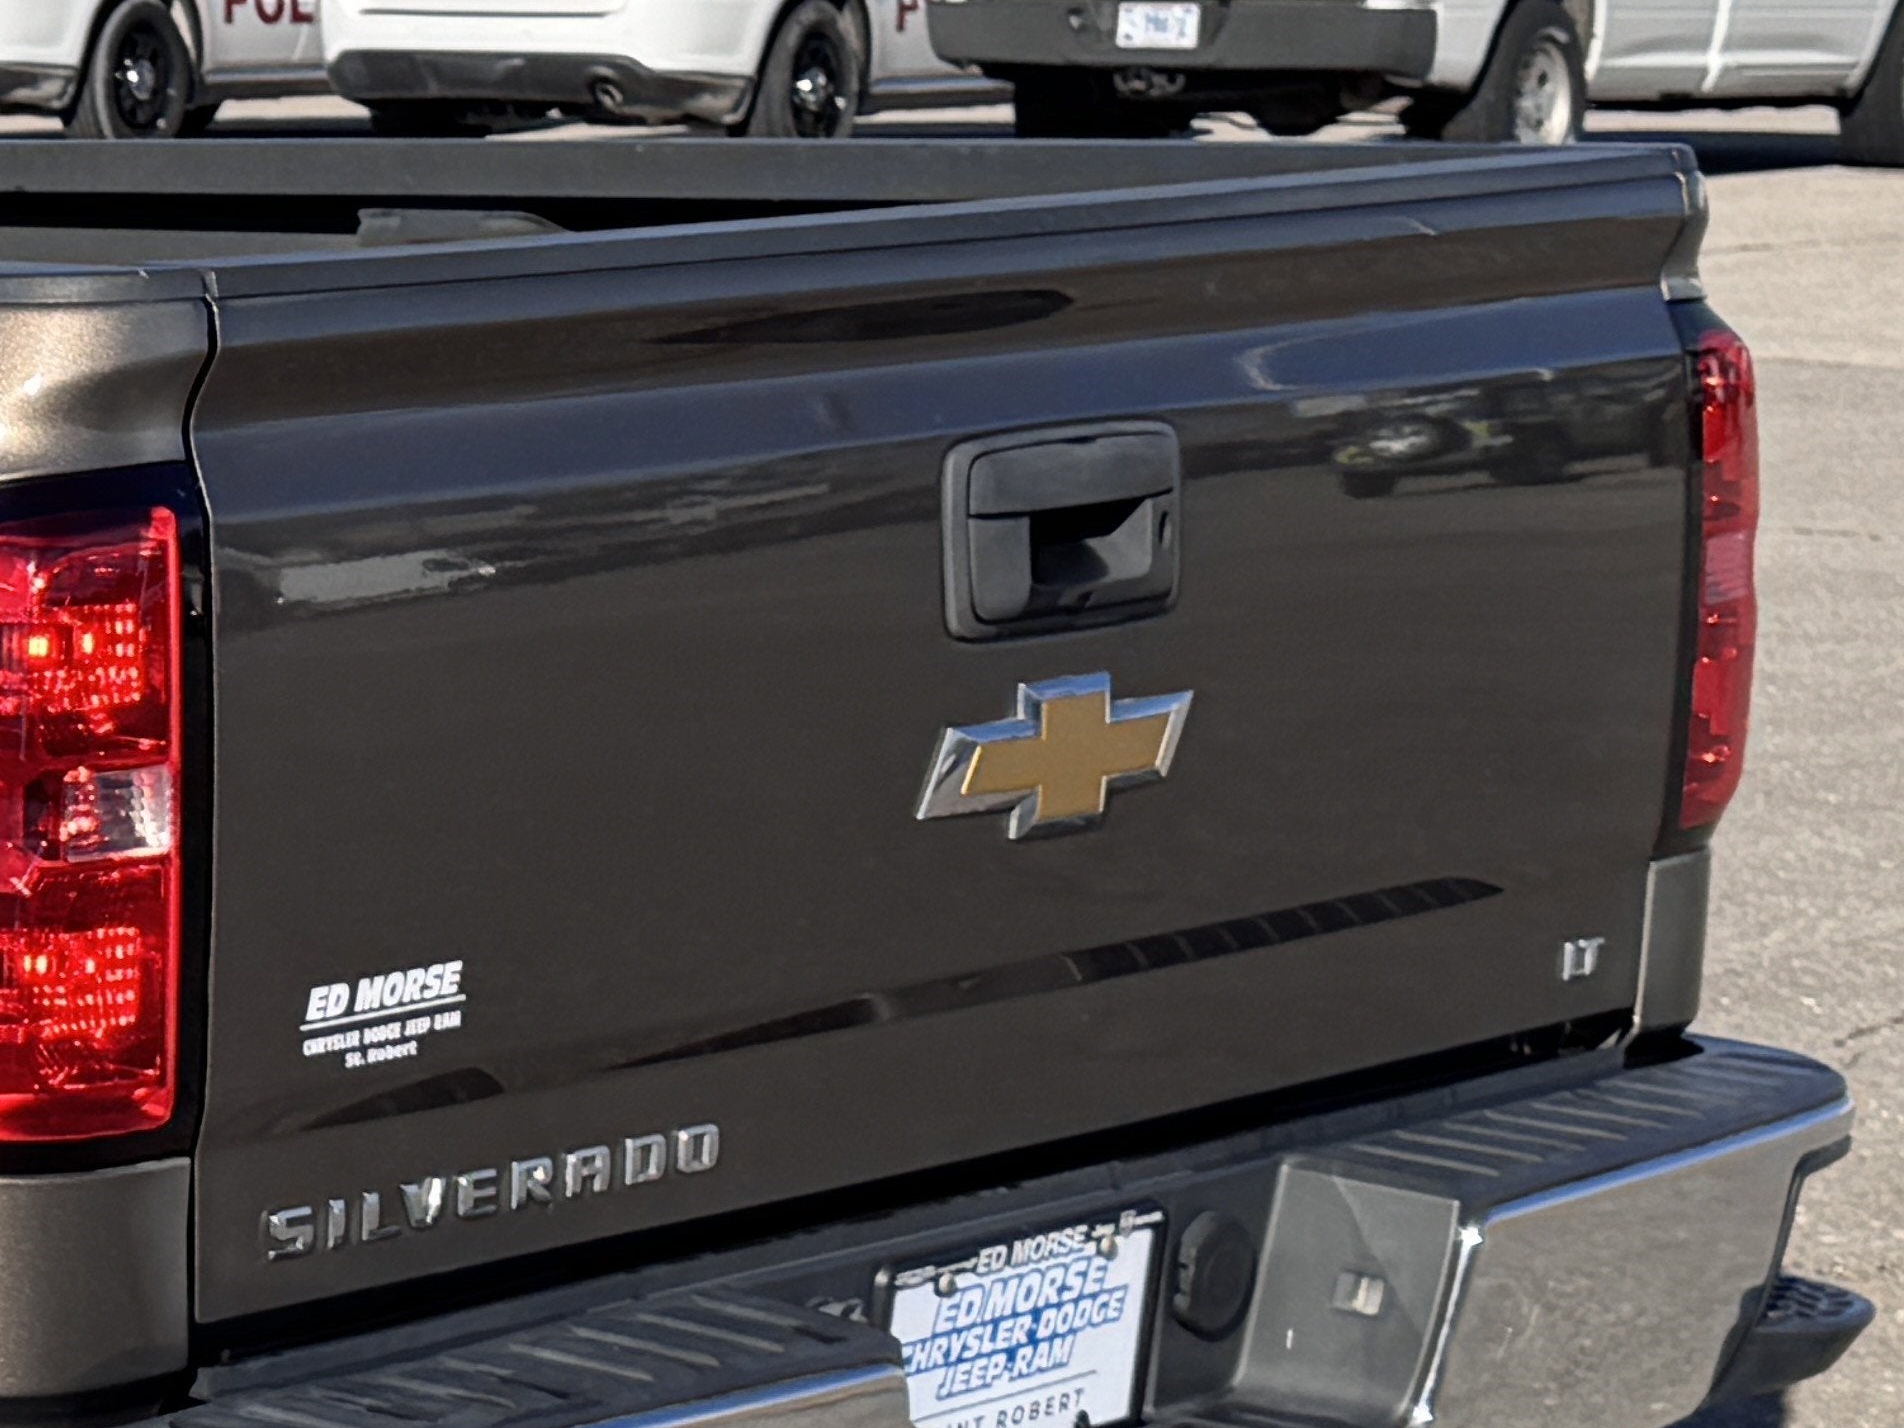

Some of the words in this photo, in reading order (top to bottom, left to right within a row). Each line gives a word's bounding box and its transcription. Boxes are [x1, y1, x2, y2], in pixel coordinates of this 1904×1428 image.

[304, 982, 351, 1021] ED
[353, 959, 464, 1013] MORSE
[302, 1029, 361, 1057] CHRYSLER
[362, 1021, 402, 1045] DODGE
[404, 1015, 431, 1037] JEEP
[366, 1040, 418, 1064] Robert
[262, 1121, 722, 1262] SILVERADO
[976, 1244, 1008, 1276] ED
[1011, 1224, 1090, 1267] MORSE
[933, 1284, 985, 1335] ED
[983, 1256, 1110, 1322] MORSE
[995, 1387, 1085, 1428] ROBERT
